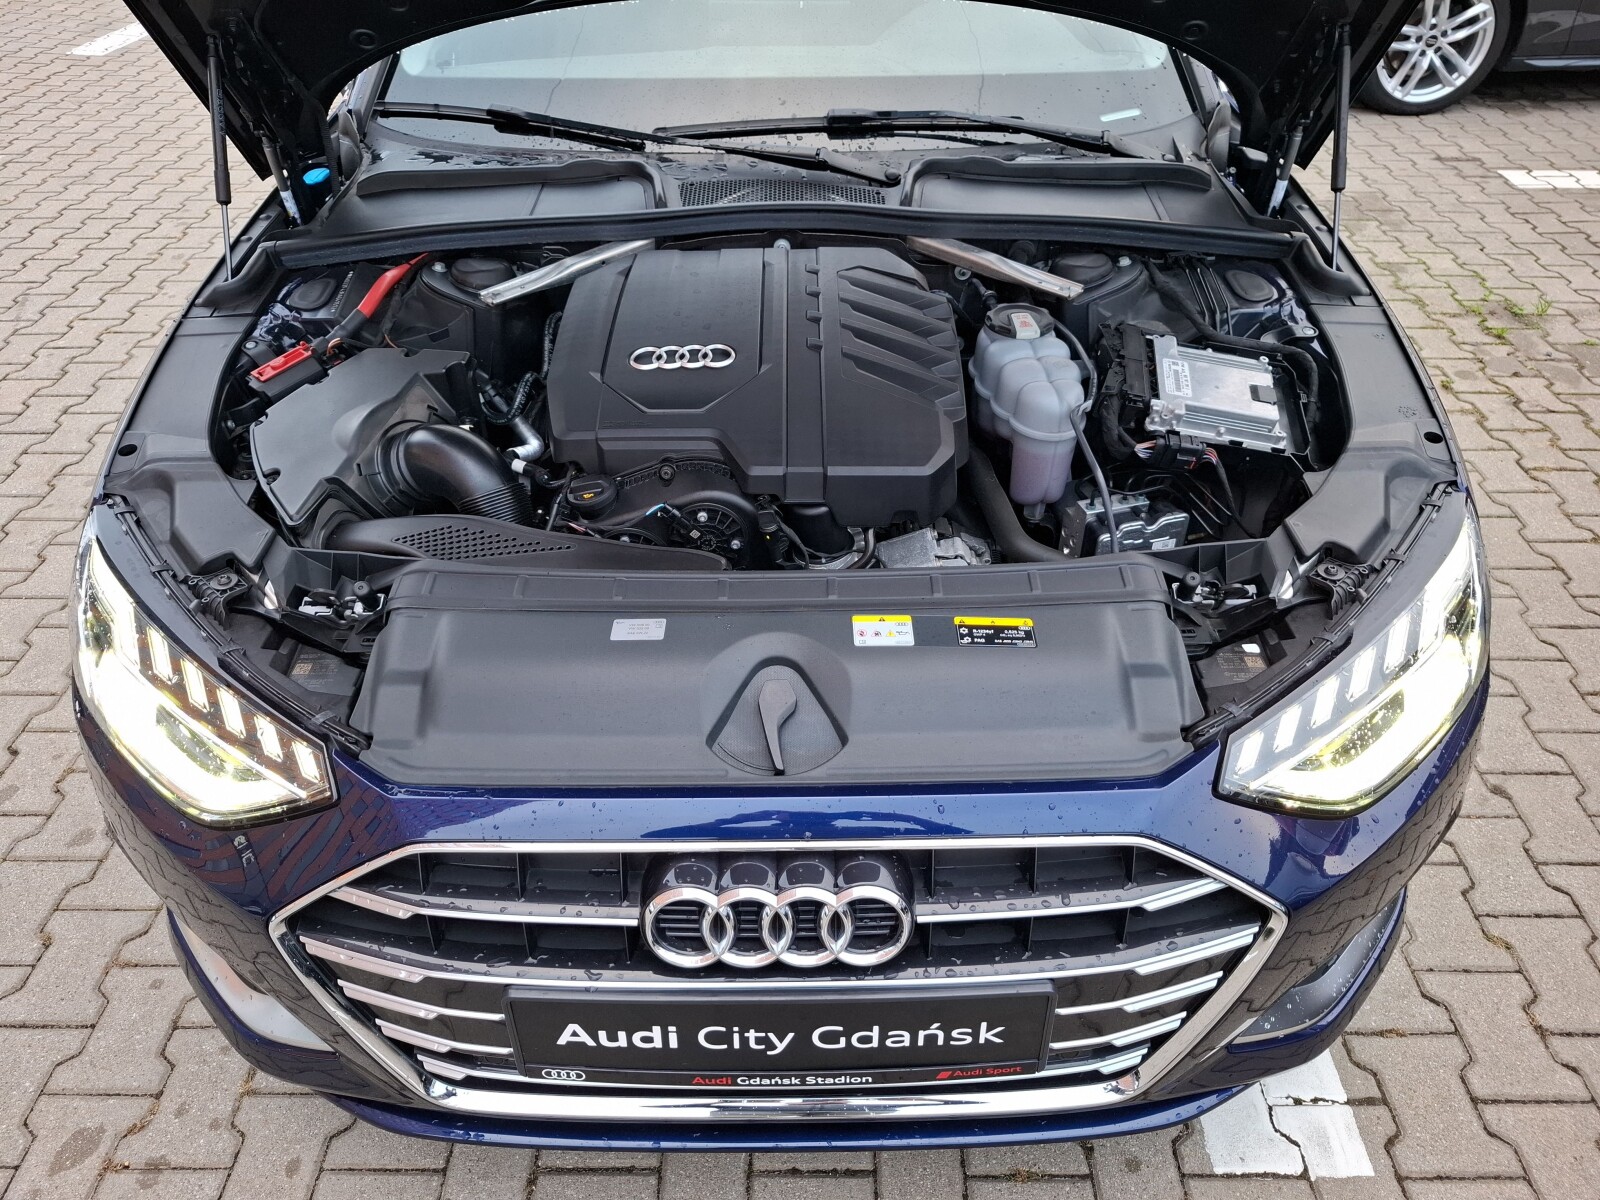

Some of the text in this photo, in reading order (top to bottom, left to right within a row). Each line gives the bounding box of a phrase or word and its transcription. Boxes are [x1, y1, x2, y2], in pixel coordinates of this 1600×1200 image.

[556, 1022, 1006, 1056] Audi City Gdańsk
[953, 1066, 1022, 1077] Audi Sport
[692, 1075, 873, 1085] Audi Gdańsk Stadion
